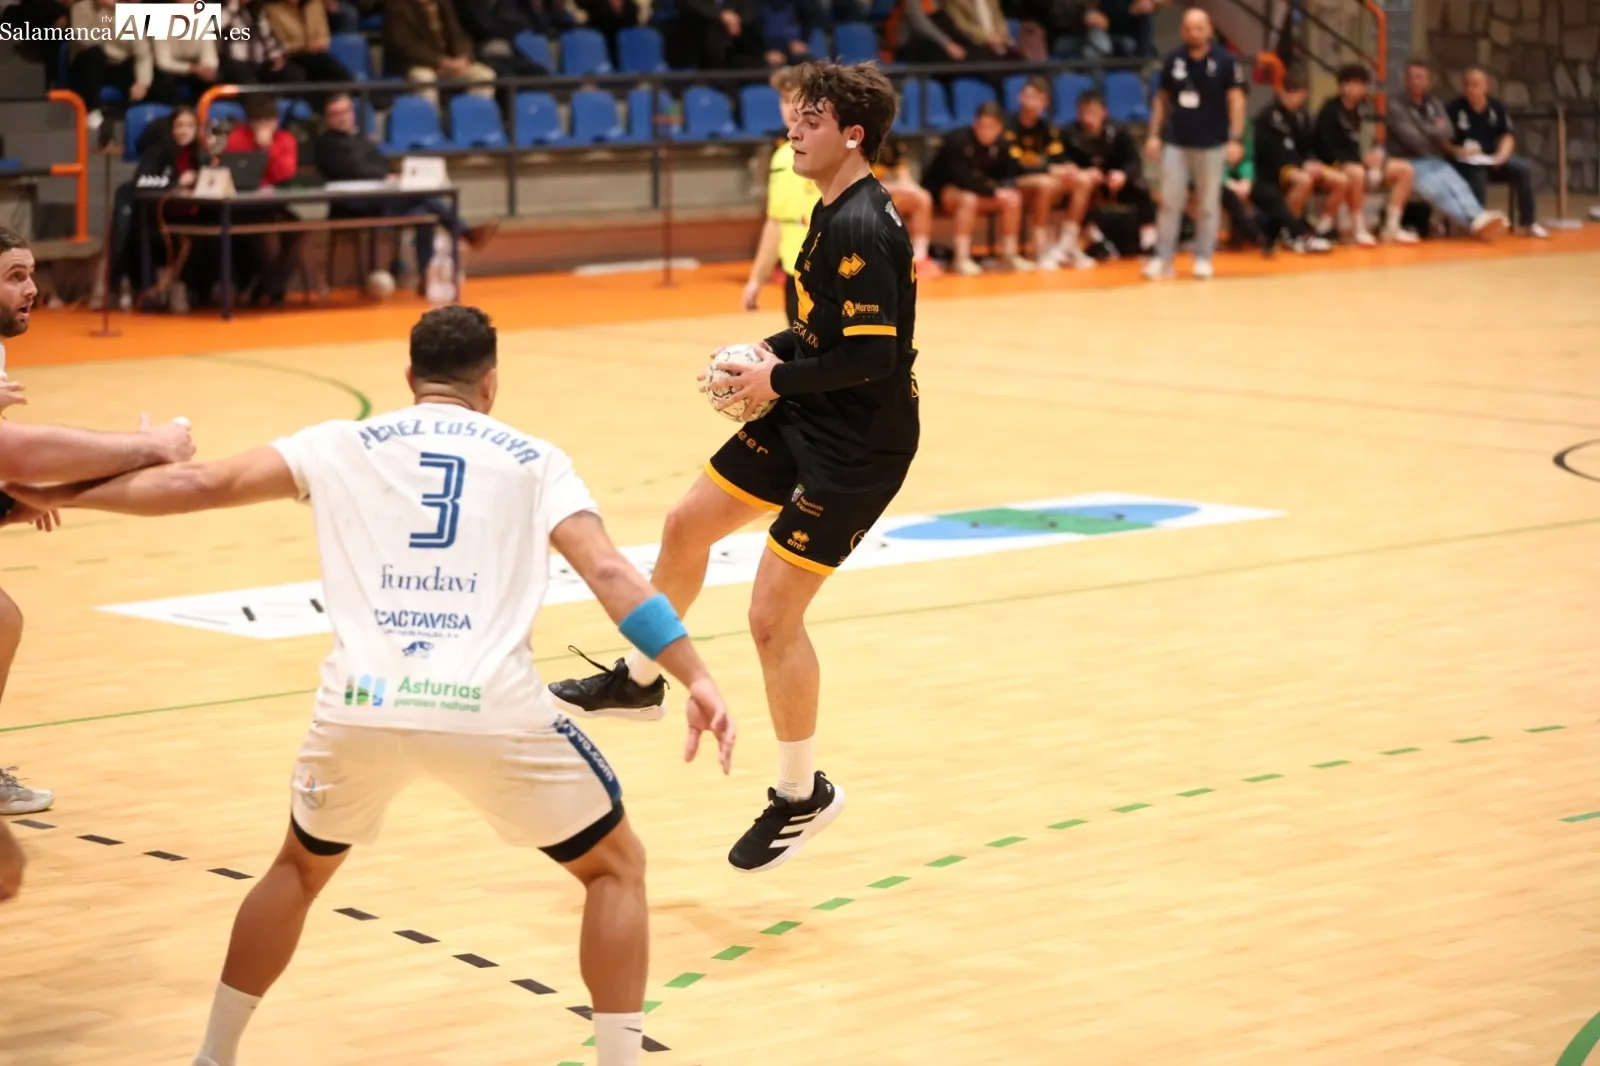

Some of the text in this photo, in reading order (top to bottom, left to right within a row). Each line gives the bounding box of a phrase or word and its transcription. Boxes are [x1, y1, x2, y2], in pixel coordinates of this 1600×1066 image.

[854, 302, 880, 313] Moreno
[408, 451, 466, 548] 3
[380, 564, 478, 593] fundavi
[397, 676, 482, 700] Asturias
